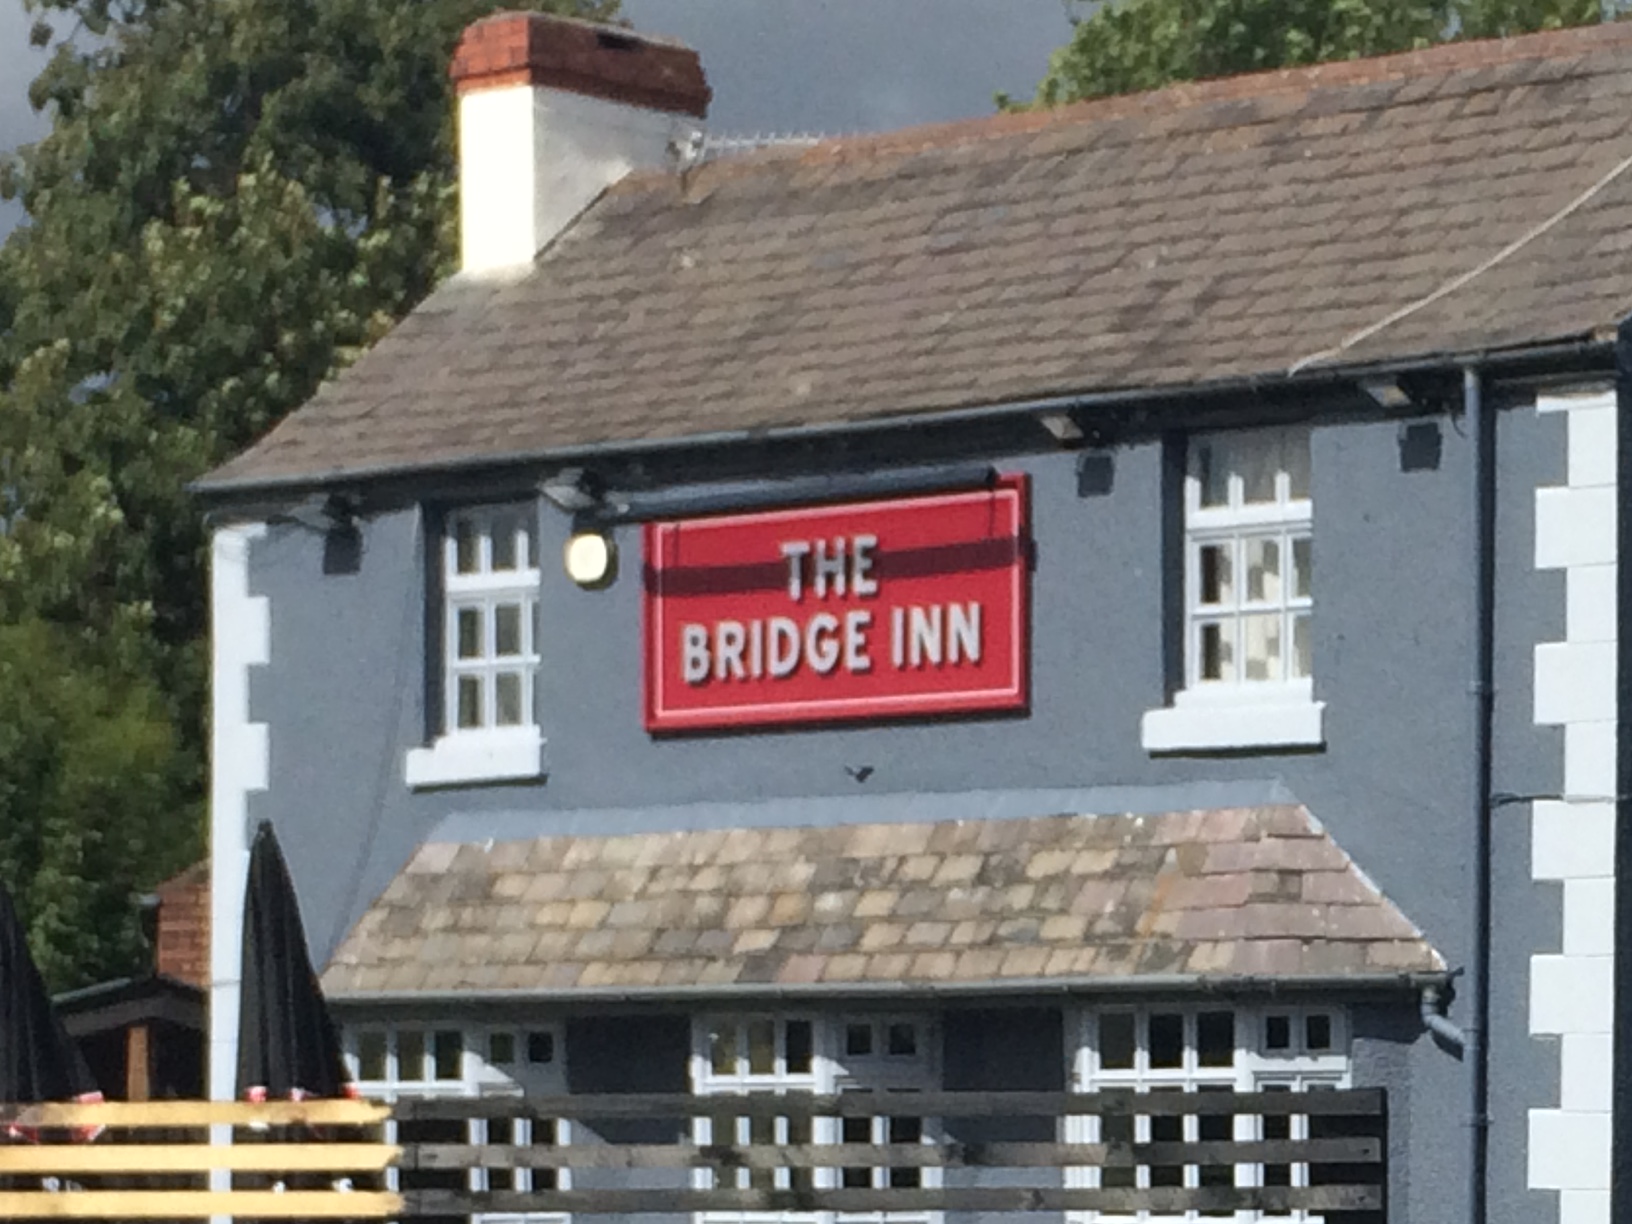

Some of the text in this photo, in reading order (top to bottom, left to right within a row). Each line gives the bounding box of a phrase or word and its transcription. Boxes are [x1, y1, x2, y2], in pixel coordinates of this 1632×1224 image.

[781, 534, 878, 600] THE
[682, 602, 981, 683] BRIDGE INN
